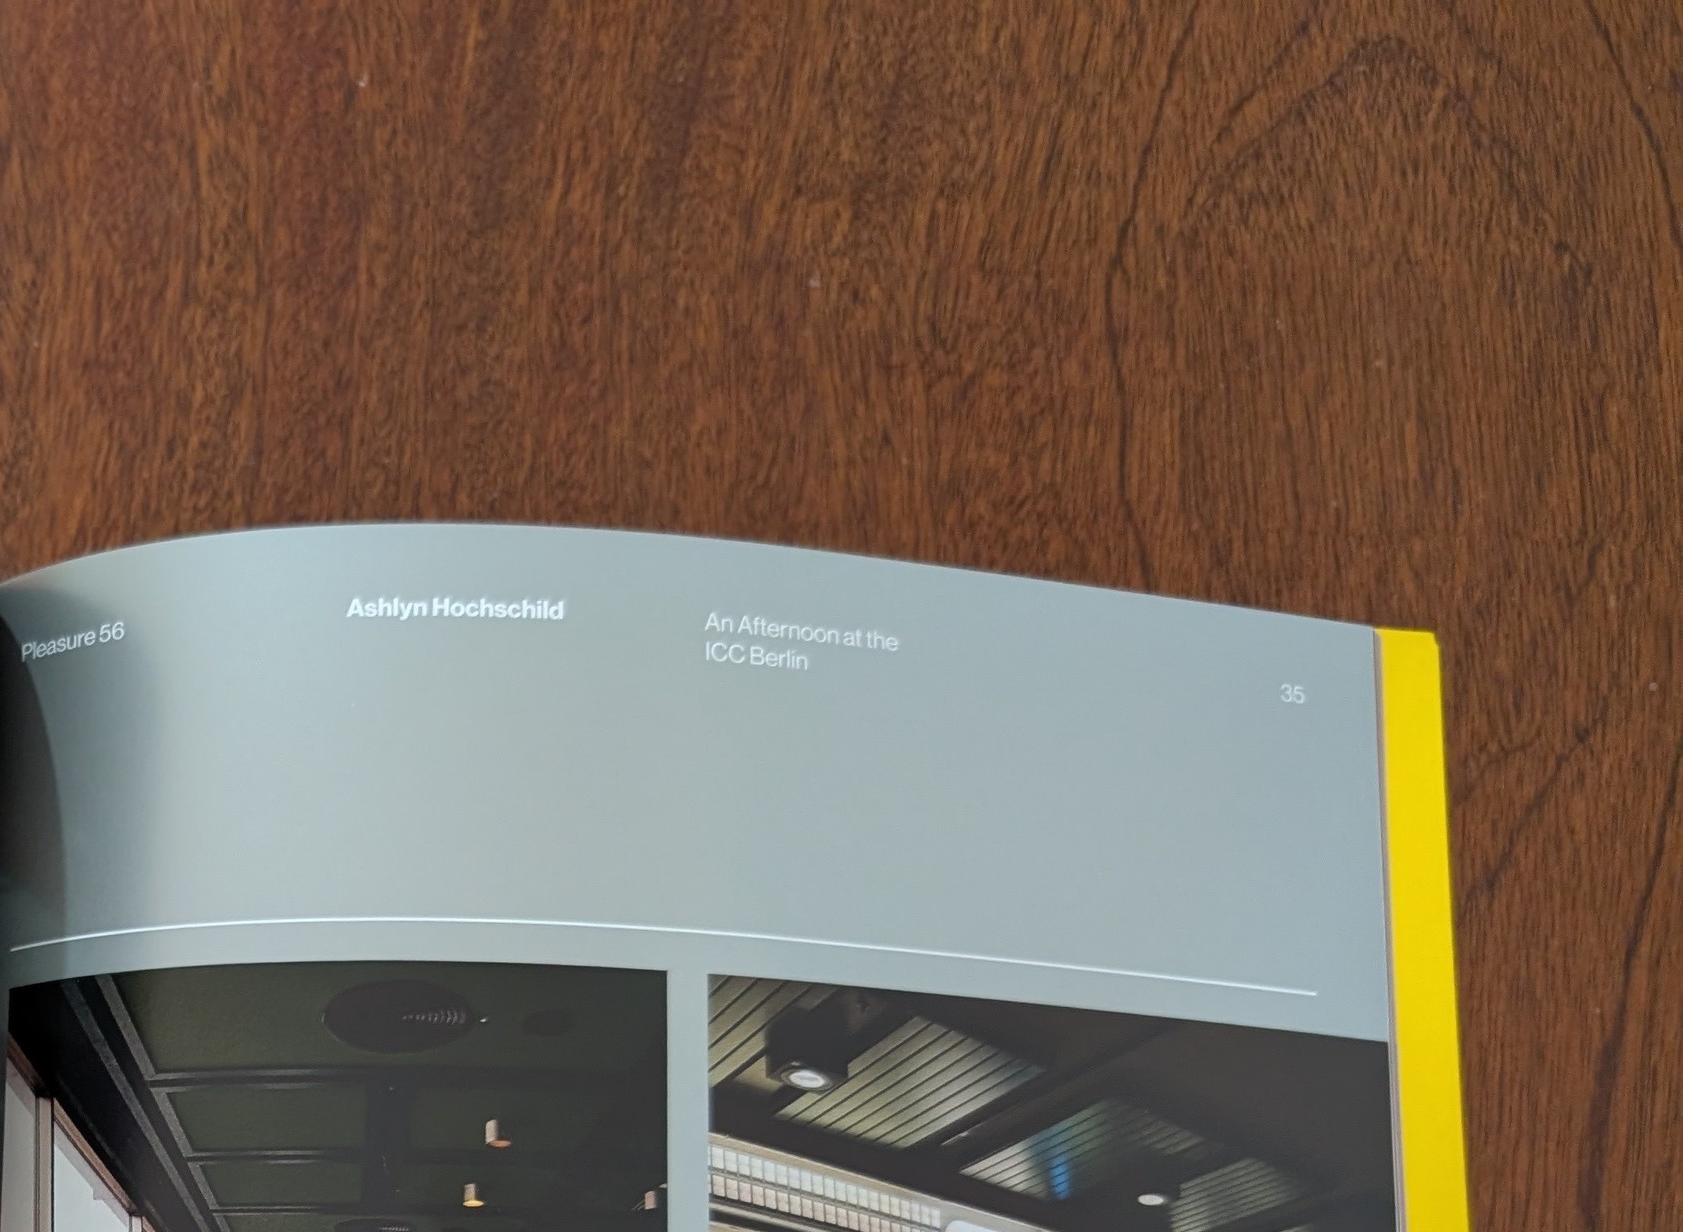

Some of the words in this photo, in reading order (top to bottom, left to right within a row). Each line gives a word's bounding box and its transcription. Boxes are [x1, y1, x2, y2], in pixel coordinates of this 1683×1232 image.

[347, 597, 427, 620] Ashlyn
[432, 597, 564, 620] Hochschild
[21, 629, 96, 662] Pleasure
[99, 621, 125, 643] 56
[706, 611, 734, 634] An
[737, 615, 842, 646] Afternoon
[844, 627, 863, 648] at
[866, 631, 899, 651] the
[706, 641, 745, 664] ICC
[750, 646, 809, 671] Berlin
[1280, 683, 1305, 704] 35
